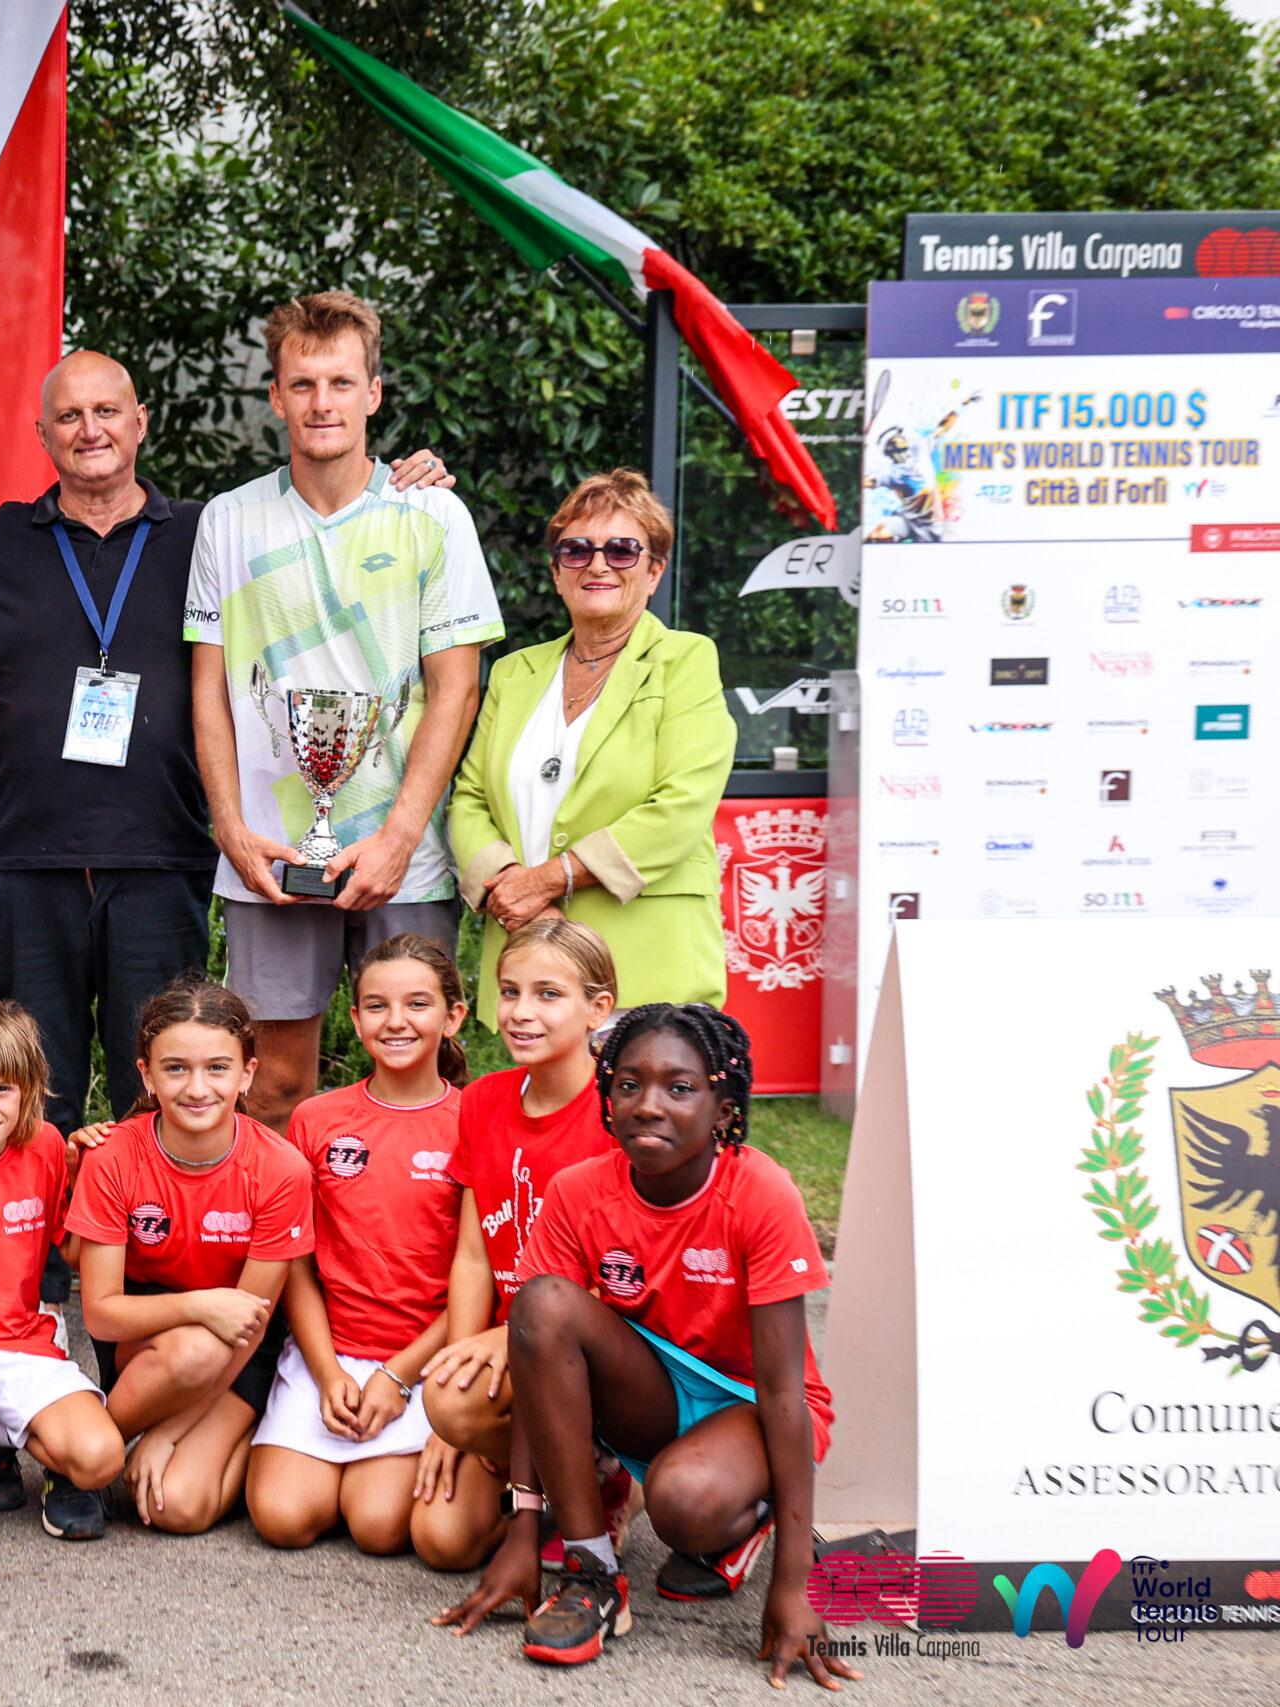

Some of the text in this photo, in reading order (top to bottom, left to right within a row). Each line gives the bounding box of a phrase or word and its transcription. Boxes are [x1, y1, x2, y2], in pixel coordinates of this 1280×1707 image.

[920, 231, 1183, 279] Tennis Villa Carpena
[998, 389, 1207, 431] ITF 15.000 $
[943, 438, 1259, 470] MEN'S WORLD TENNIS TOUR
[1026, 476, 1167, 506] Città di Forlì
[326, 1147, 369, 1166] CTA
[482, 1199, 513, 1237] Ball
[599, 1261, 645, 1284] CTA
[1011, 1464, 1280, 1496] ASSESSORAT
